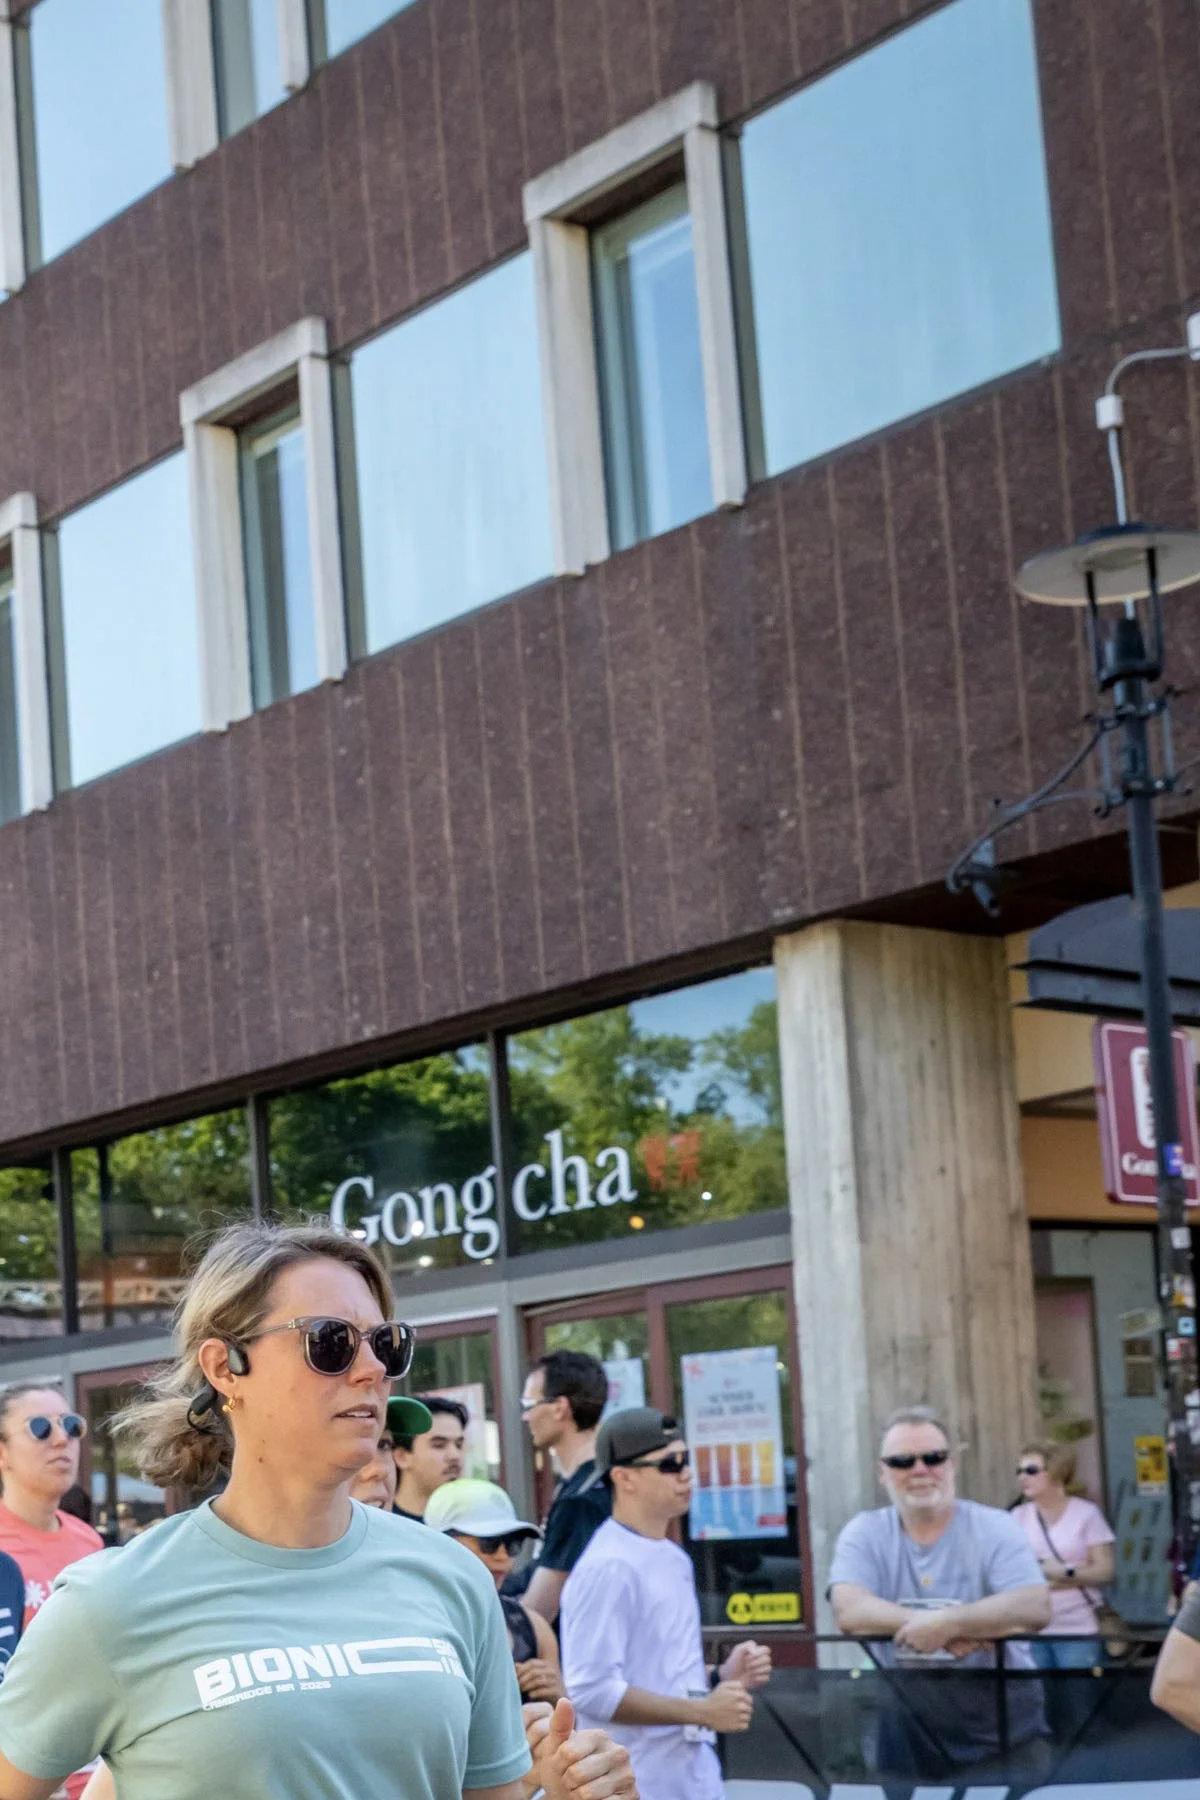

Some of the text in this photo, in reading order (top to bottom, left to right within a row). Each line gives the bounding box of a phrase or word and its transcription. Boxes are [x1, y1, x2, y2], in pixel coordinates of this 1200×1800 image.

[330, 1129, 638, 1259] Gong cha
[193, 1637, 444, 1704] BIONIC
[203, 1685, 272, 1711] CAMBRIDGE
